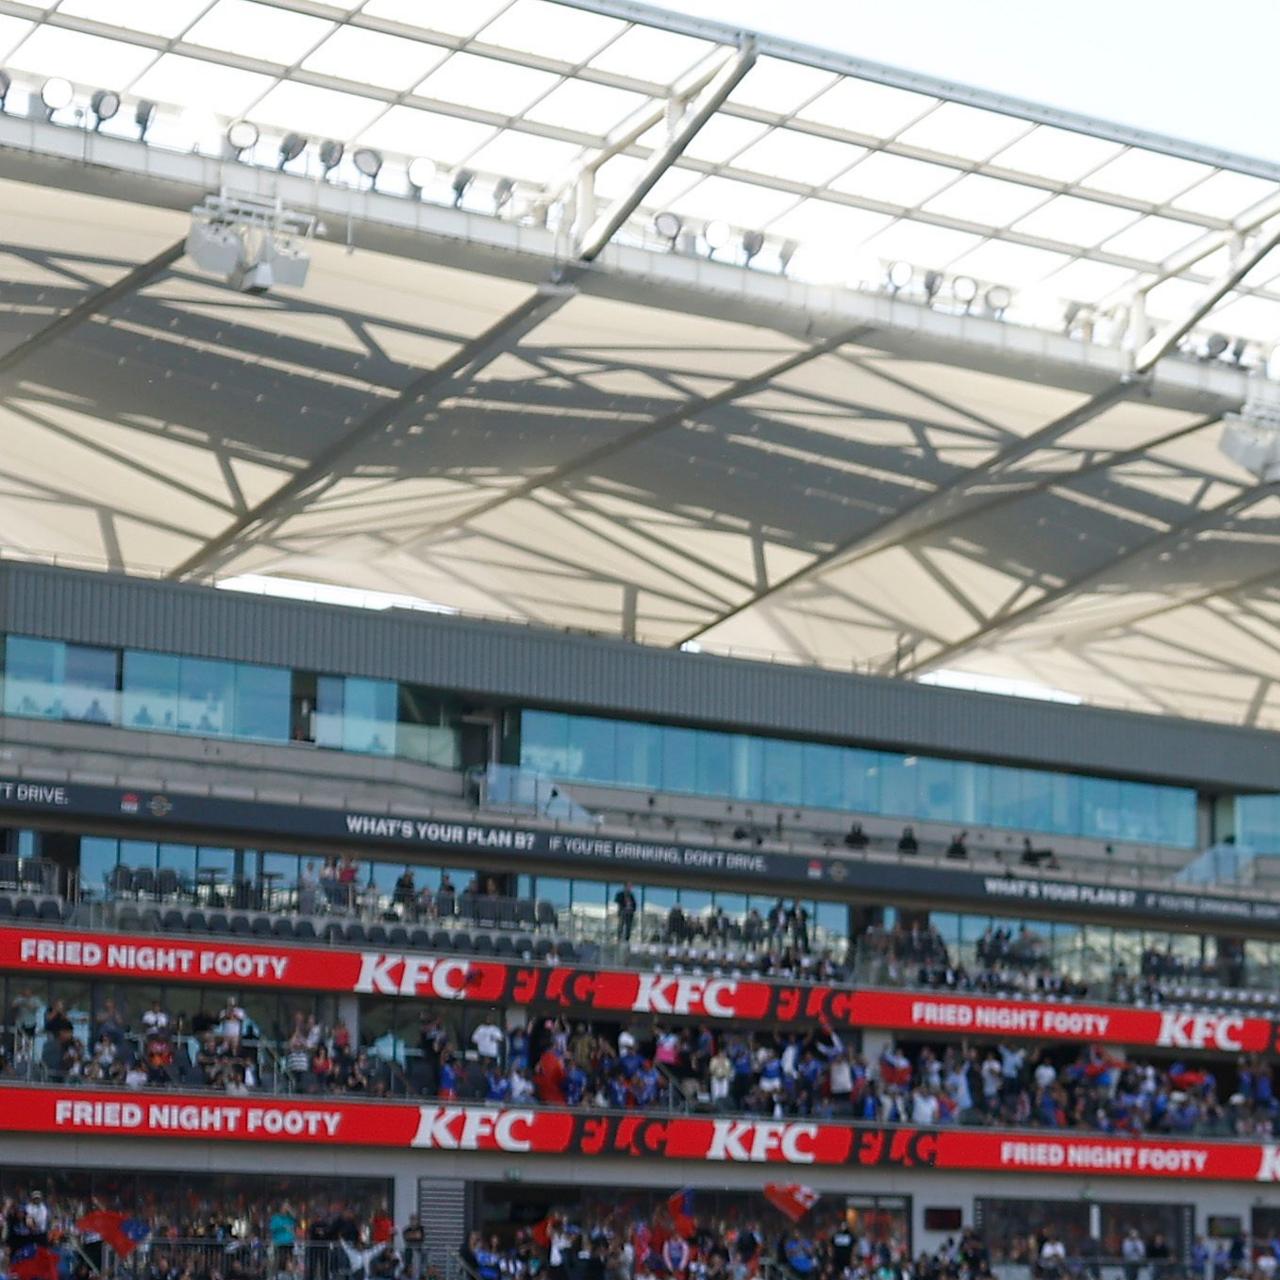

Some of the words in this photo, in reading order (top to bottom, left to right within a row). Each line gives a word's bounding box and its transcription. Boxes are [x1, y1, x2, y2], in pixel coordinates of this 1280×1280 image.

[17, 785, 69, 805] DRIVE.
[346, 815, 414, 838] WHAT'S
[417, 822, 462, 843] YOUR
[466, 828, 510, 848] PLAN
[514, 831, 535, 850] B?
[549, 836, 561, 850] IF
[565, 838, 612, 858] YOU'RE
[684, 849, 723, 869] DON'T
[726, 851, 767, 872] DRIVE.
[20, 938, 101, 966] FRIED
[107, 944, 194, 972] NIGHT
[199, 951, 288, 980] FOOTY
[353, 952, 470, 1000] KFC
[632, 973, 737, 1018] KFC
[911, 1002, 972, 1026] FRIED
[976, 1006, 1040, 1030] NIGHT
[1043, 1011, 1109, 1035] FOOTY
[1156, 1011, 1244, 1051] KFC
[55, 1100, 142, 1128] FRIED
[150, 1104, 241, 1132] NIGHT
[247, 1108, 341, 1136] FOOTY
[410, 1106, 534, 1152] KFC
[706, 1119, 818, 1164] KFC
[1001, 1141, 1064, 1166] FRIED
[1067, 1145, 1136, 1170] NIGHT
[1138, 1148, 1207, 1172] FOOTY
